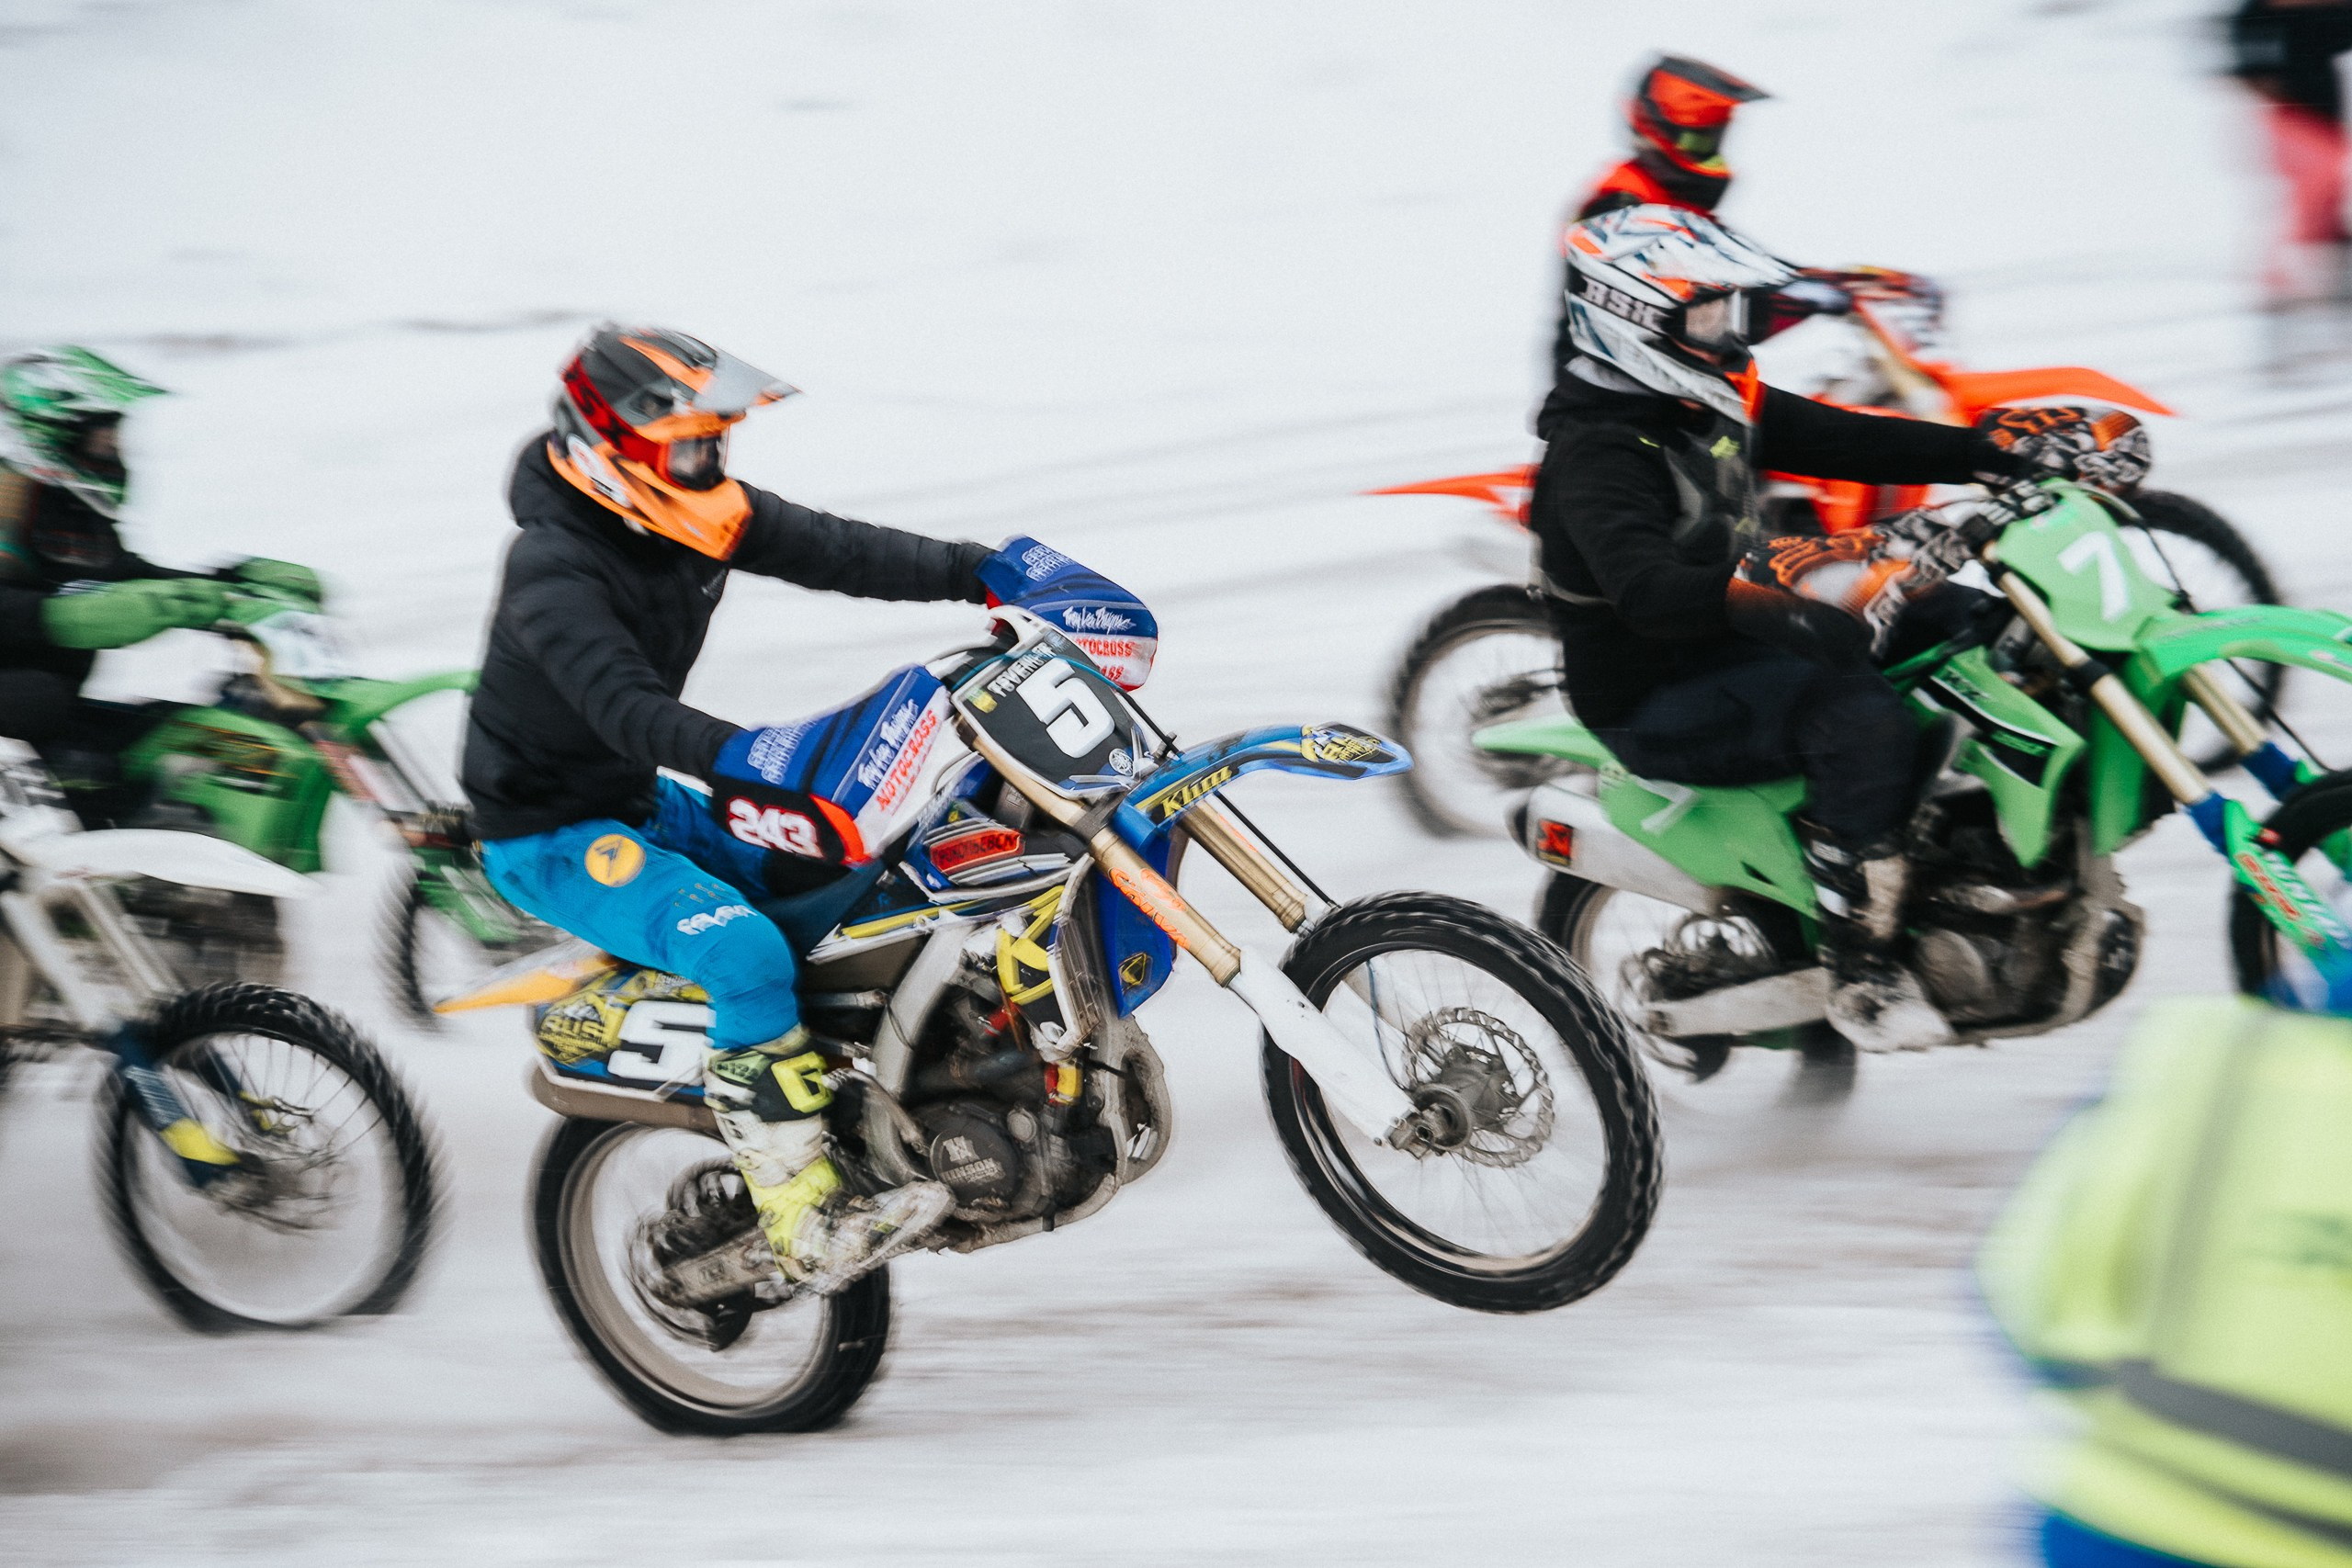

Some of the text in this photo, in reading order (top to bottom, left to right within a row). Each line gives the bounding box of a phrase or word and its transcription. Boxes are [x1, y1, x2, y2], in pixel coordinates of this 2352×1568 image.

[2057, 530, 2129, 624] 7
[1016, 657, 1114, 759] 5
[729, 797, 826, 859] 243
[607, 1000, 717, 1086] 5
